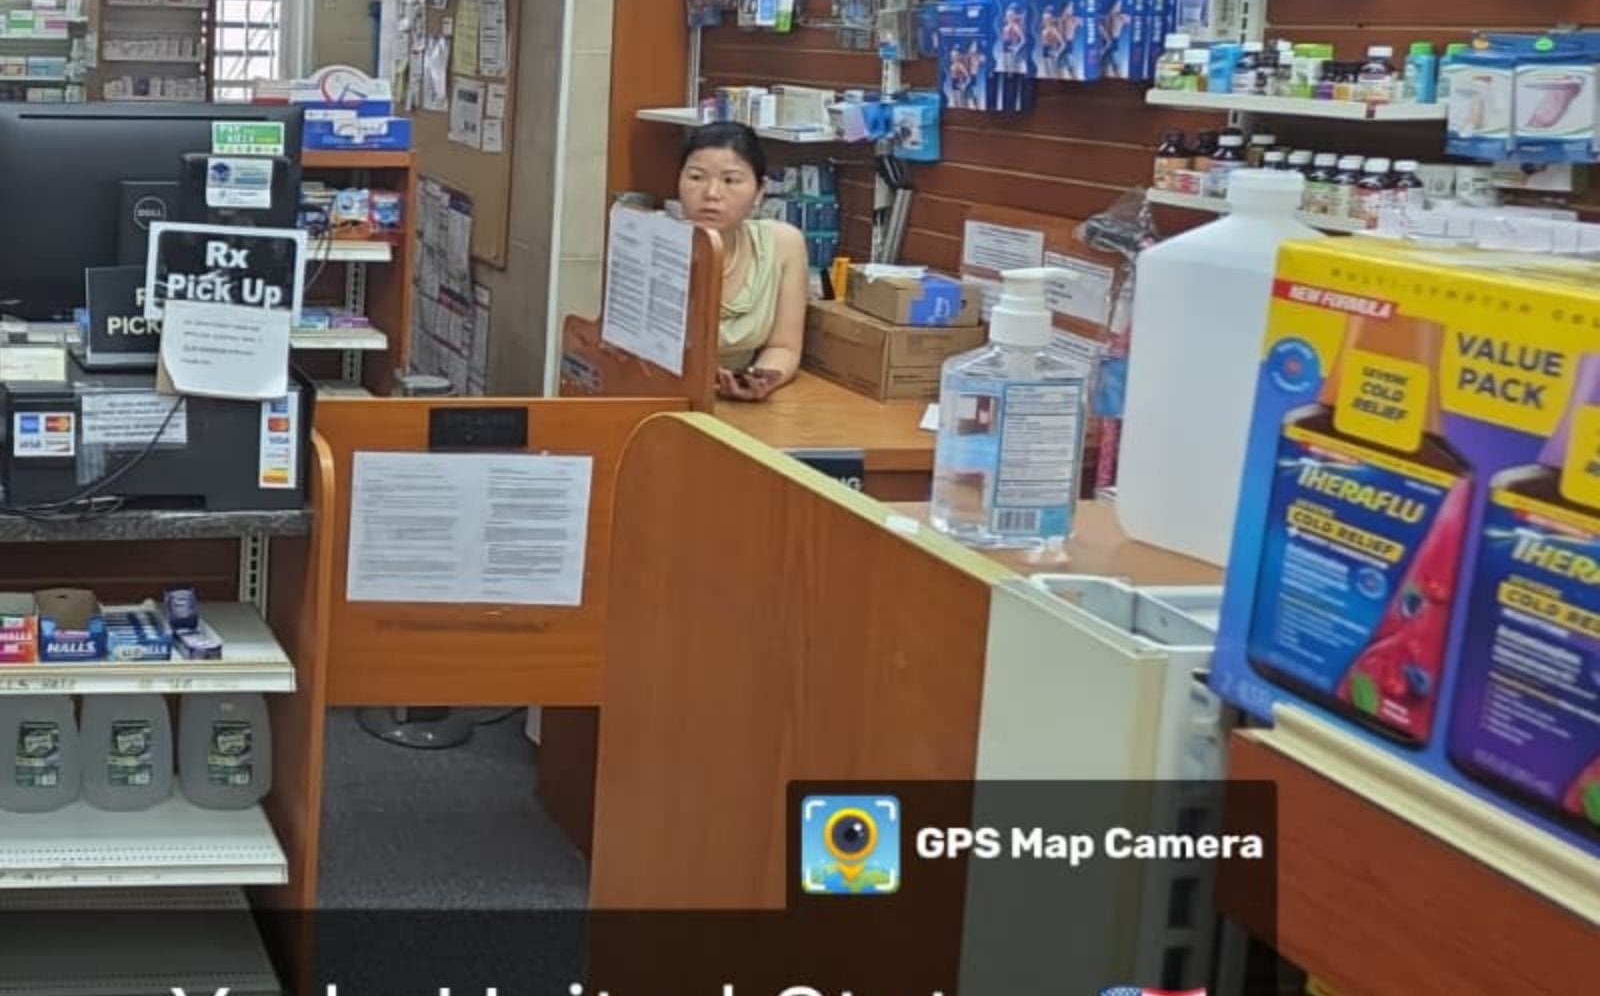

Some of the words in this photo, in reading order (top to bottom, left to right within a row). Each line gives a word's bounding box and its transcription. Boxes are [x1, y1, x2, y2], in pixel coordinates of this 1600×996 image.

[204, 240, 249, 269] Rx
[166, 272, 233, 302] Pick
[241, 278, 283, 310] Up
[1288, 284, 1319, 304] NEW
[1321, 291, 1393, 319] FORMULA
[106, 315, 161, 336] PICK
[1456, 331, 1567, 378] VALUE
[1360, 380, 1405, 403] COLD
[1362, 365, 1409, 388] SEVERE
[1457, 367, 1547, 411] PACK
[1352, 397, 1409, 423] RELIEF
[1297, 458, 1426, 524] THERAFLU
[1293, 508, 1332, 535] COLD
[1336, 525, 1396, 557] RELIEF
[1511, 526, 1600, 586] THER
[1507, 588, 1561, 619] COLD
[46, 640, 97, 654] HALLS
